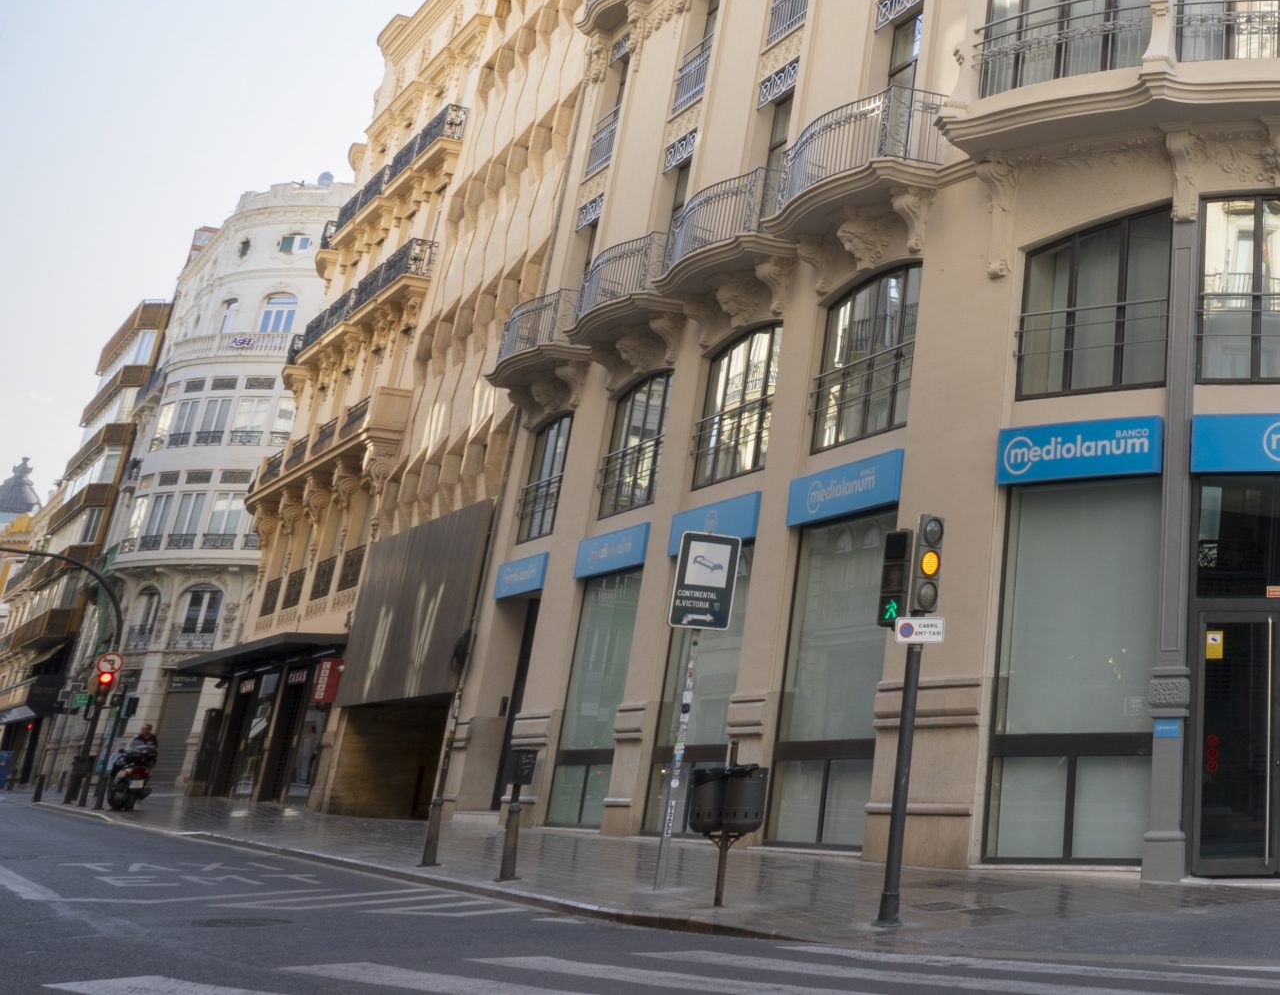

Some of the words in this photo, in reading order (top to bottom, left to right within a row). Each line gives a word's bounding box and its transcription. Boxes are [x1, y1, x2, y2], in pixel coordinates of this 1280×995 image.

[1115, 428, 1149, 438] BANCO
[1009, 435, 1149, 464] mediolanum
[809, 474, 875, 504] mediolanum
[677, 590, 717, 600] CONTINENTAL
[288, 669, 308, 684] CASAS
[57, 862, 283, 872] TAXI
[94, 874, 323, 887] EMT
